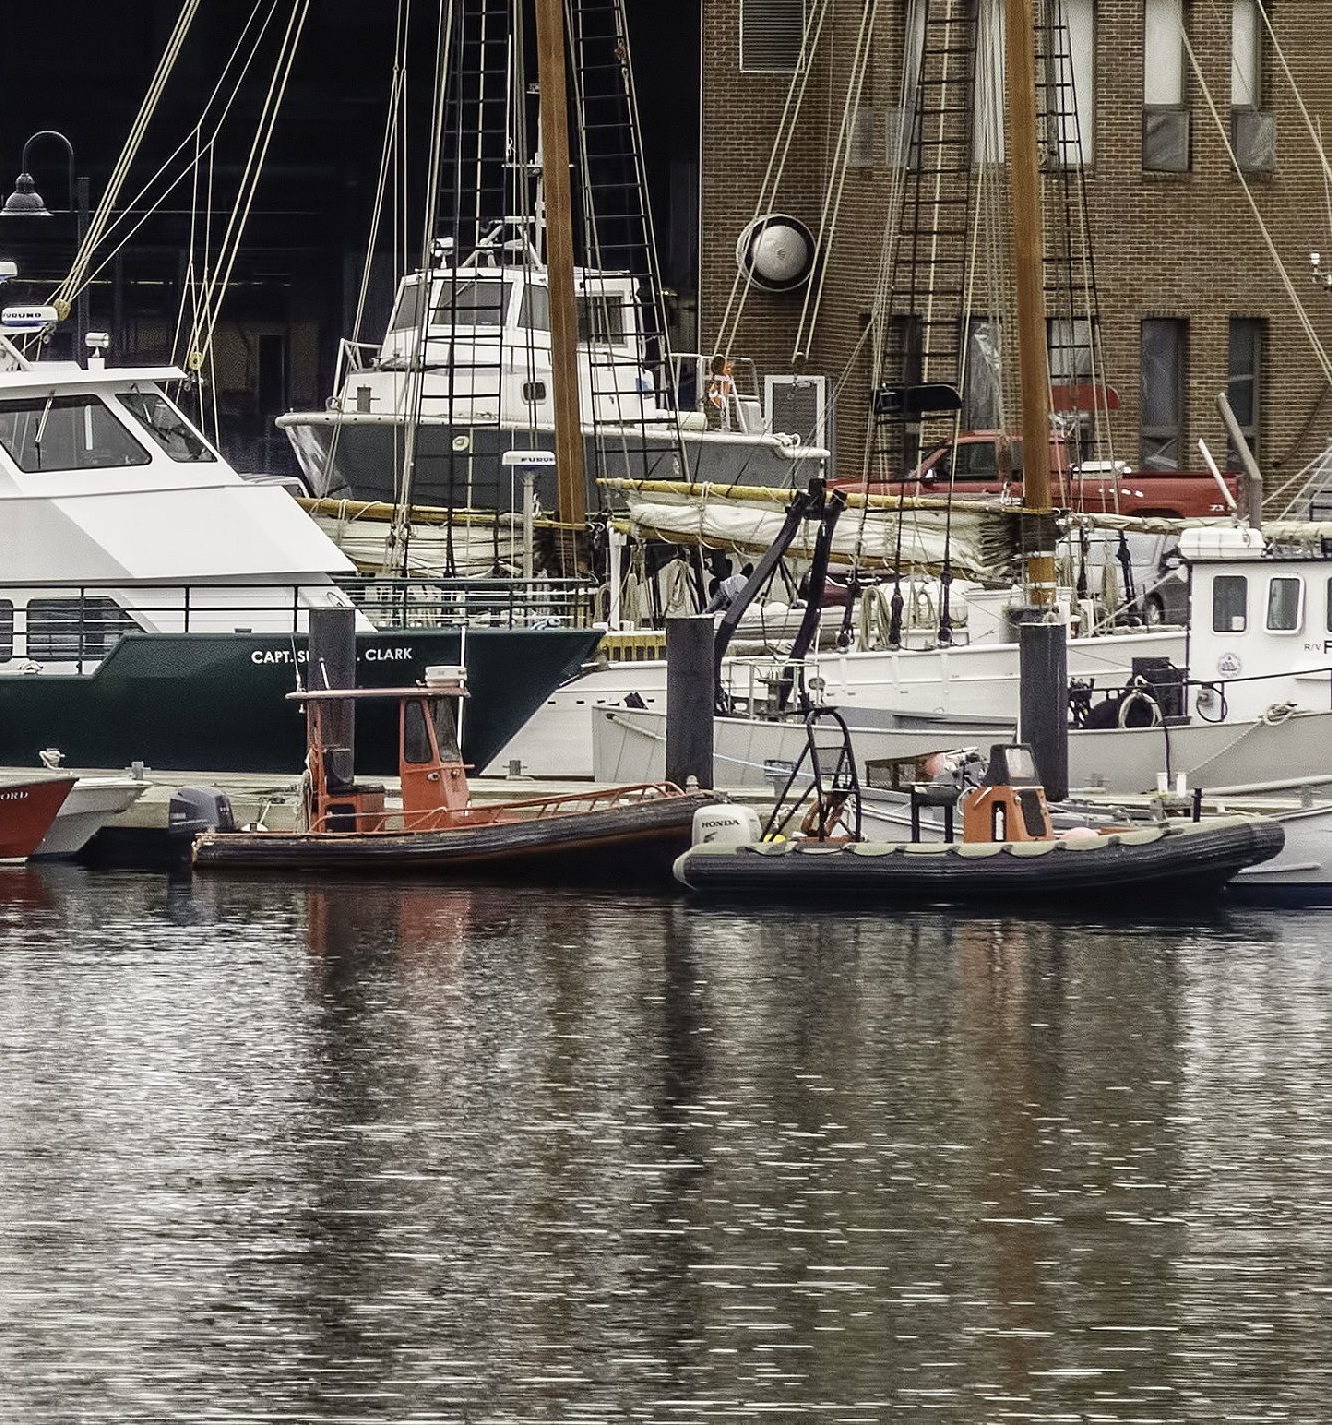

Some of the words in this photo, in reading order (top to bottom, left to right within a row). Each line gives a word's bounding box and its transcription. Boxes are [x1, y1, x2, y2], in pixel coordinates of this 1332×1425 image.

[251, 650, 294, 664] CAPT.
[365, 647, 412, 661] CLARK
[701, 819, 741, 829] HONDA
